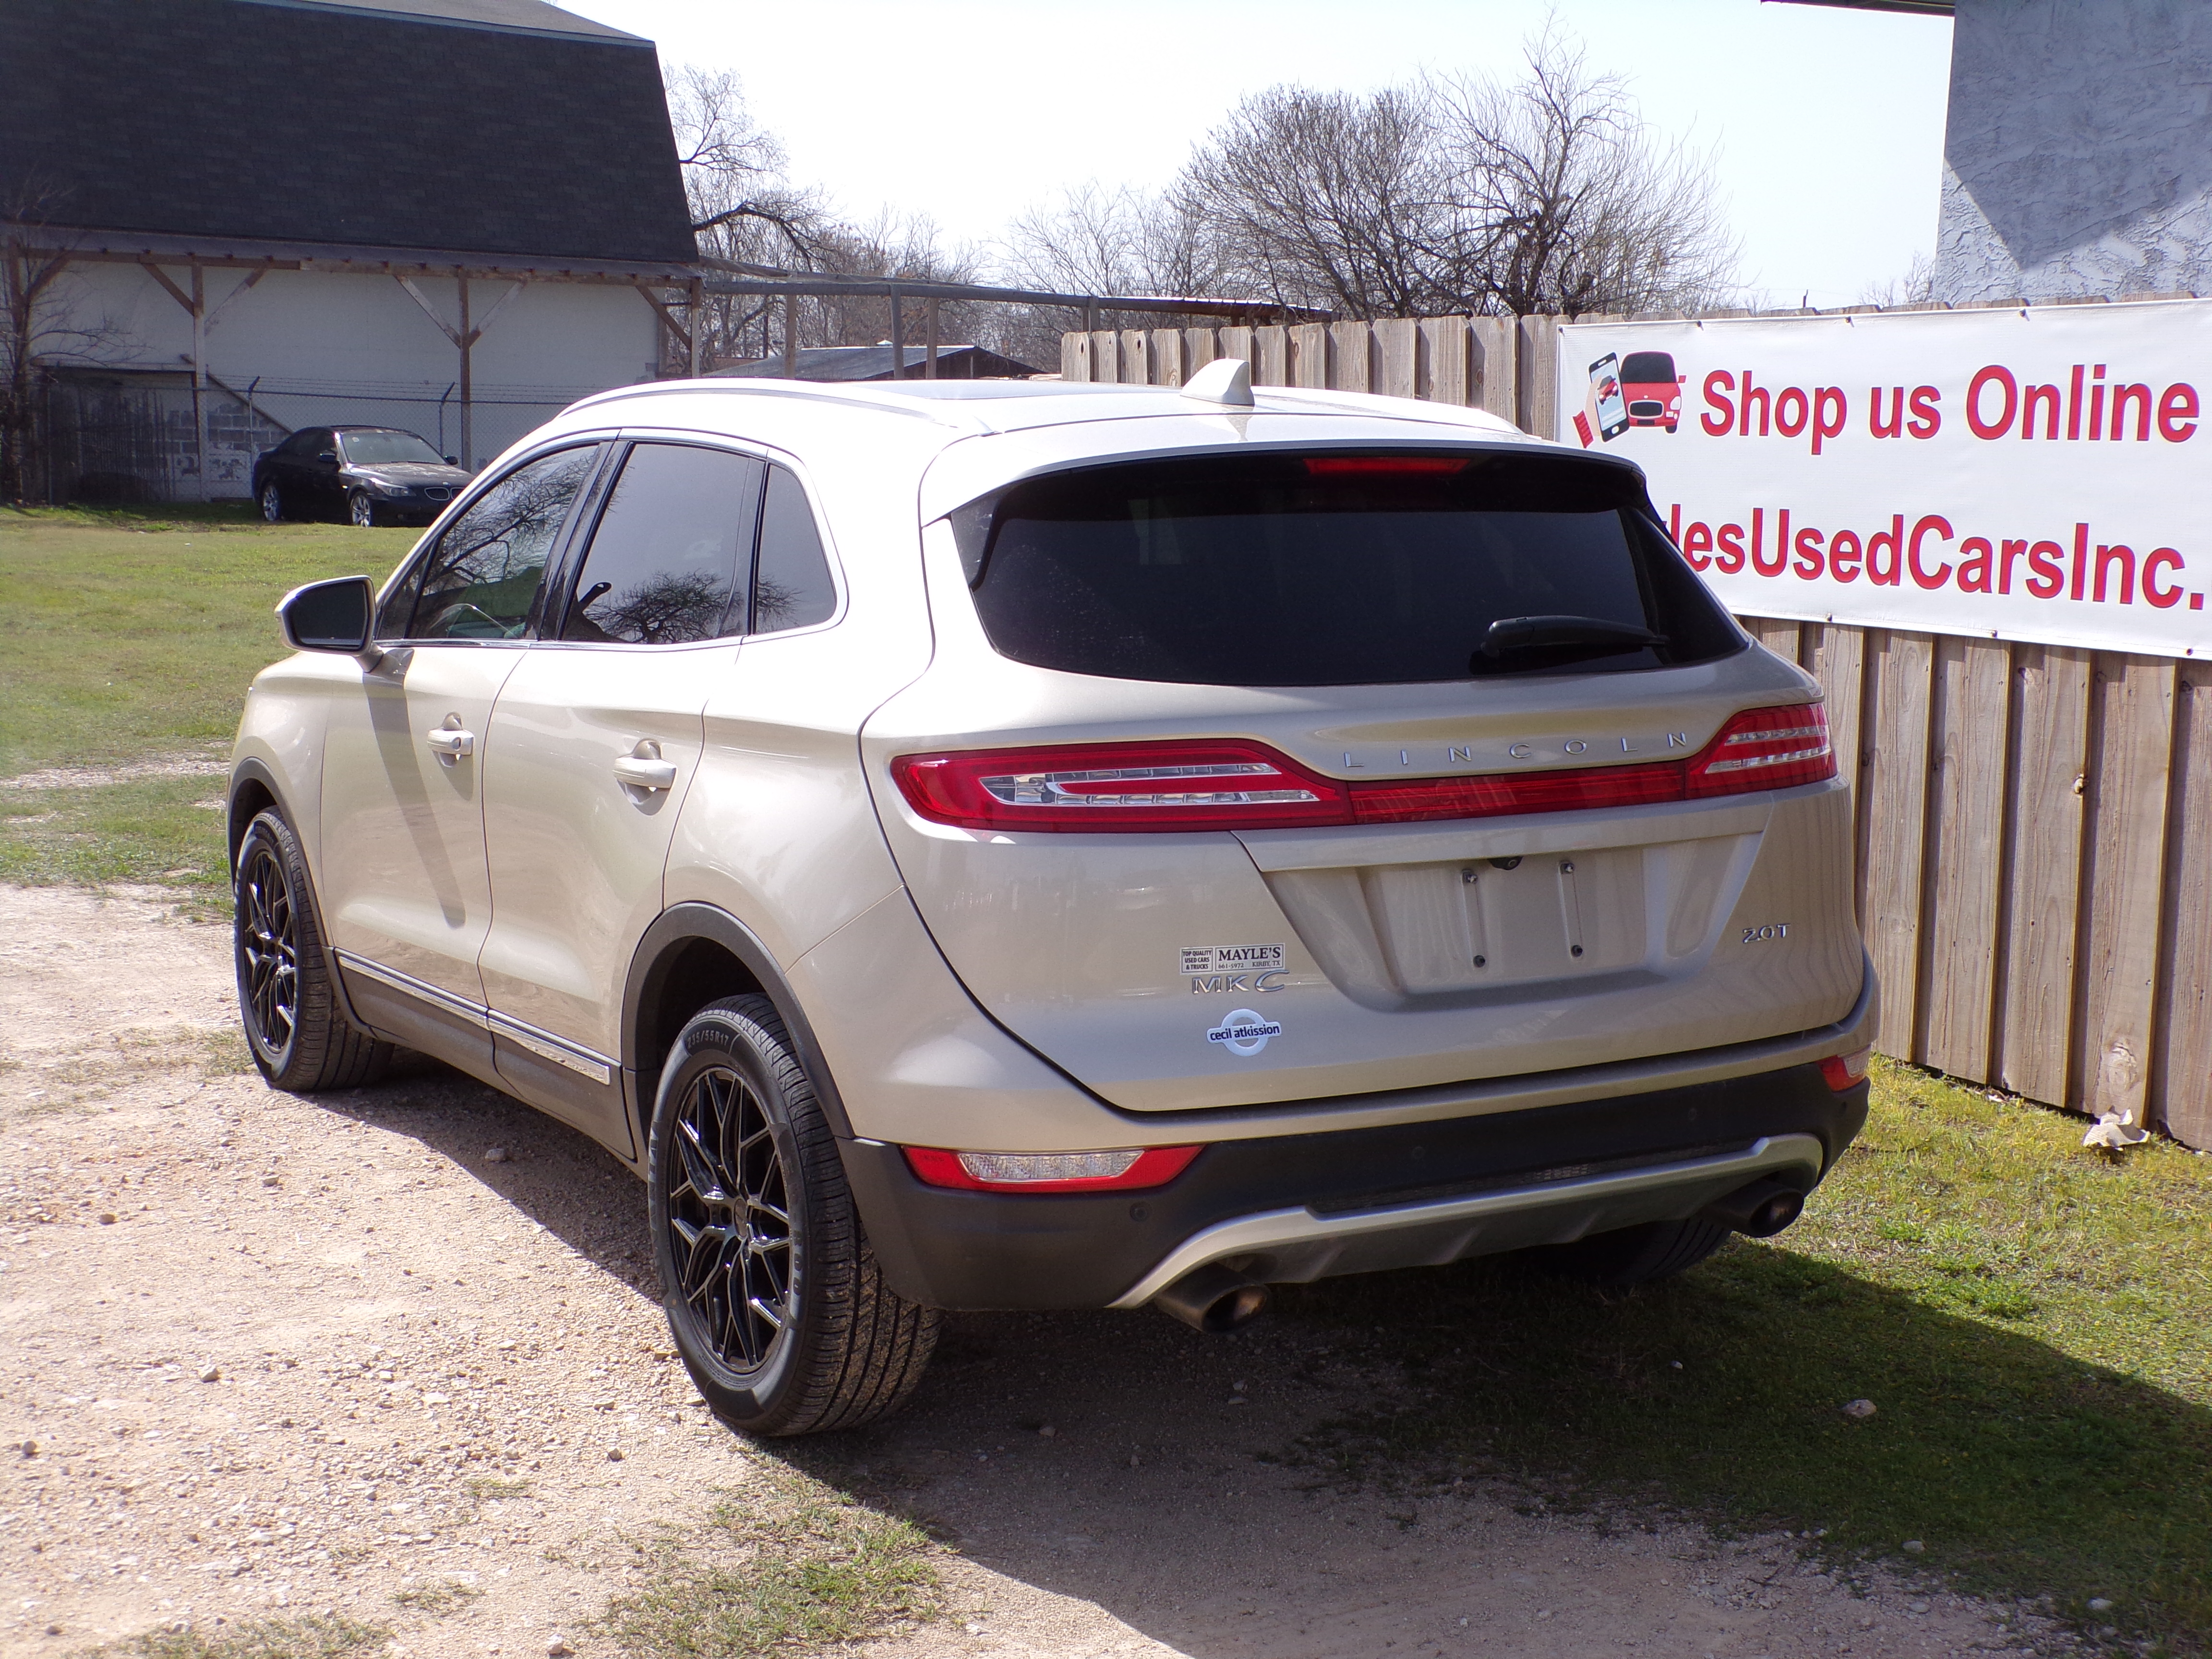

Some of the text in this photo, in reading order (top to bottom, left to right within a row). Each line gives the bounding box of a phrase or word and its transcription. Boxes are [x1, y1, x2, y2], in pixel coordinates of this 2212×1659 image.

[1700, 364, 2200, 456] Shop us Online
[1662, 504, 2204, 610] lesUsedCarsInc.
[1344, 732, 1687, 768] LINCOLN
[1218, 947, 1281, 961] MAYLE'S
[1192, 969, 1290, 994] MKC
[1210, 1023, 1280, 1041] cecil atkission
